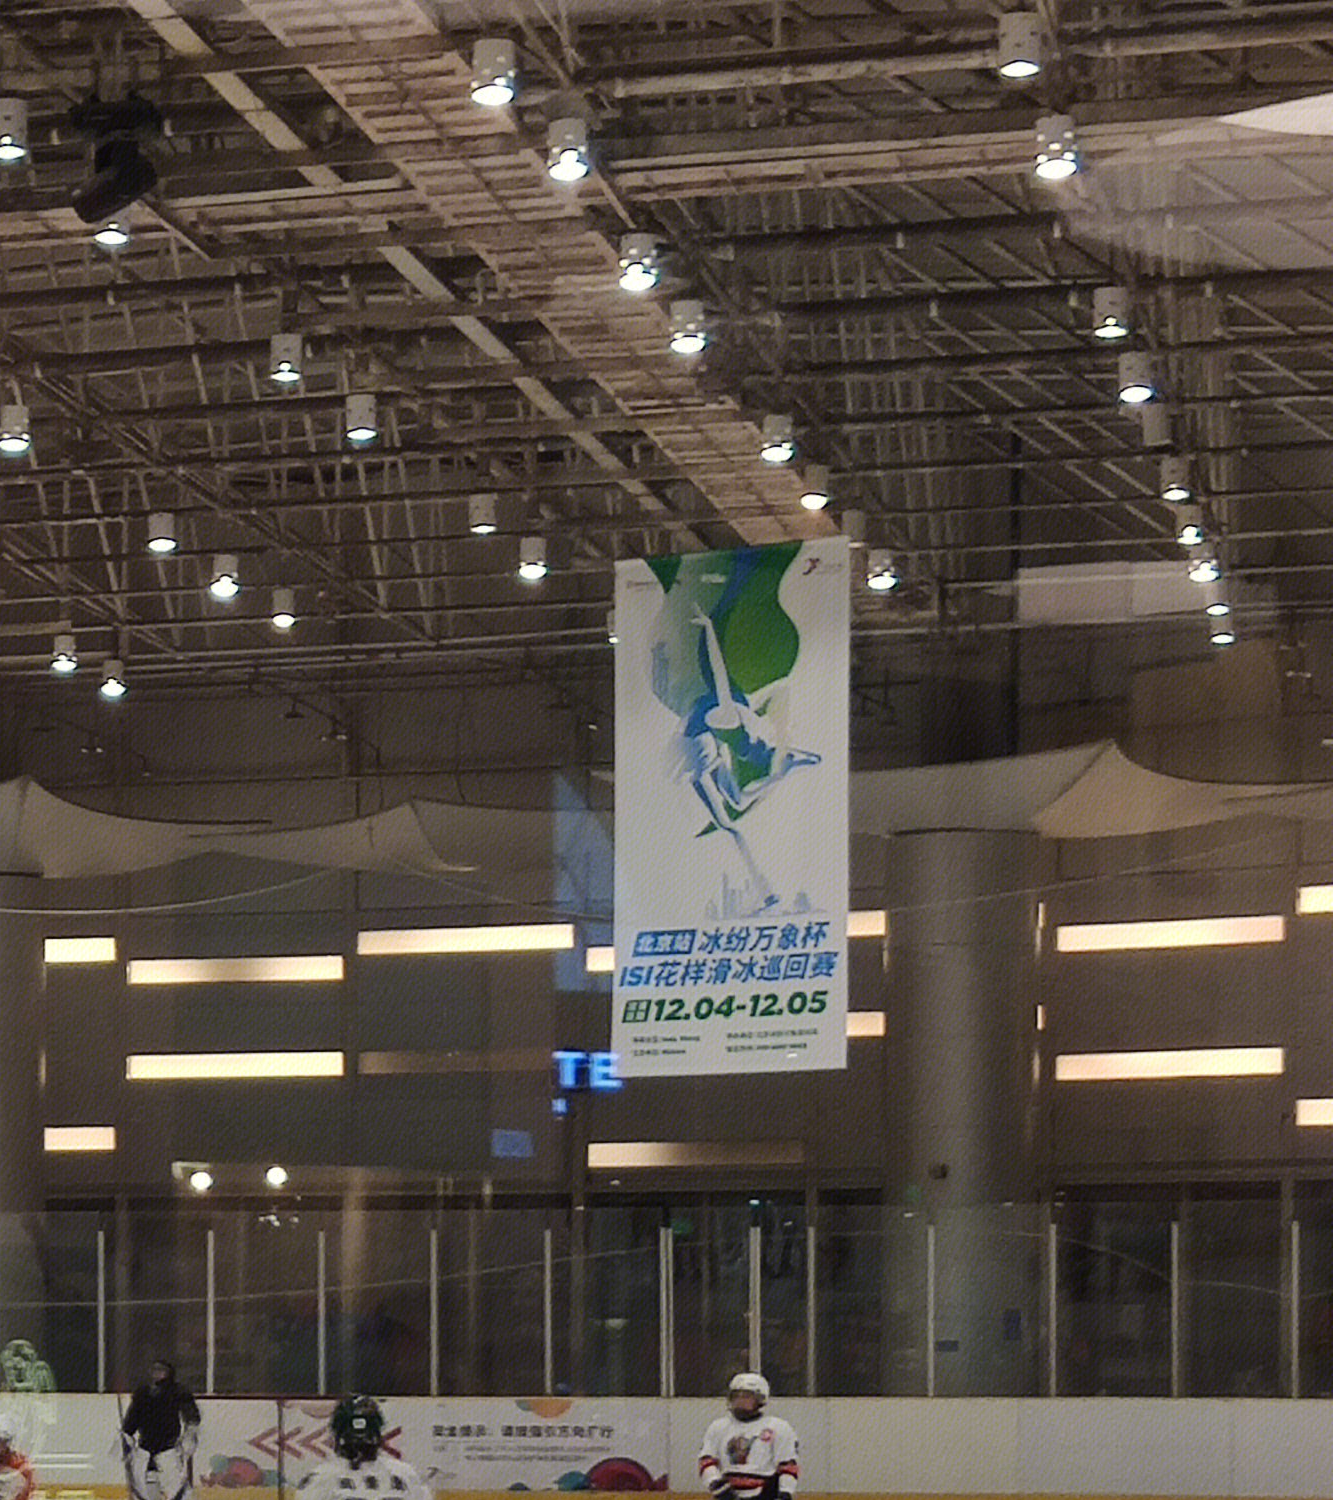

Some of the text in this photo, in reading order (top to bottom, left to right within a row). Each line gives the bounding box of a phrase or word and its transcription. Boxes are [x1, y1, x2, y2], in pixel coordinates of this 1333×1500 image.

[698, 921, 830, 954] 冰纷万象杯
[619, 951, 839, 988] ISI花样滑冰巡回赛
[654, 990, 828, 1022] 12.04-12.05
